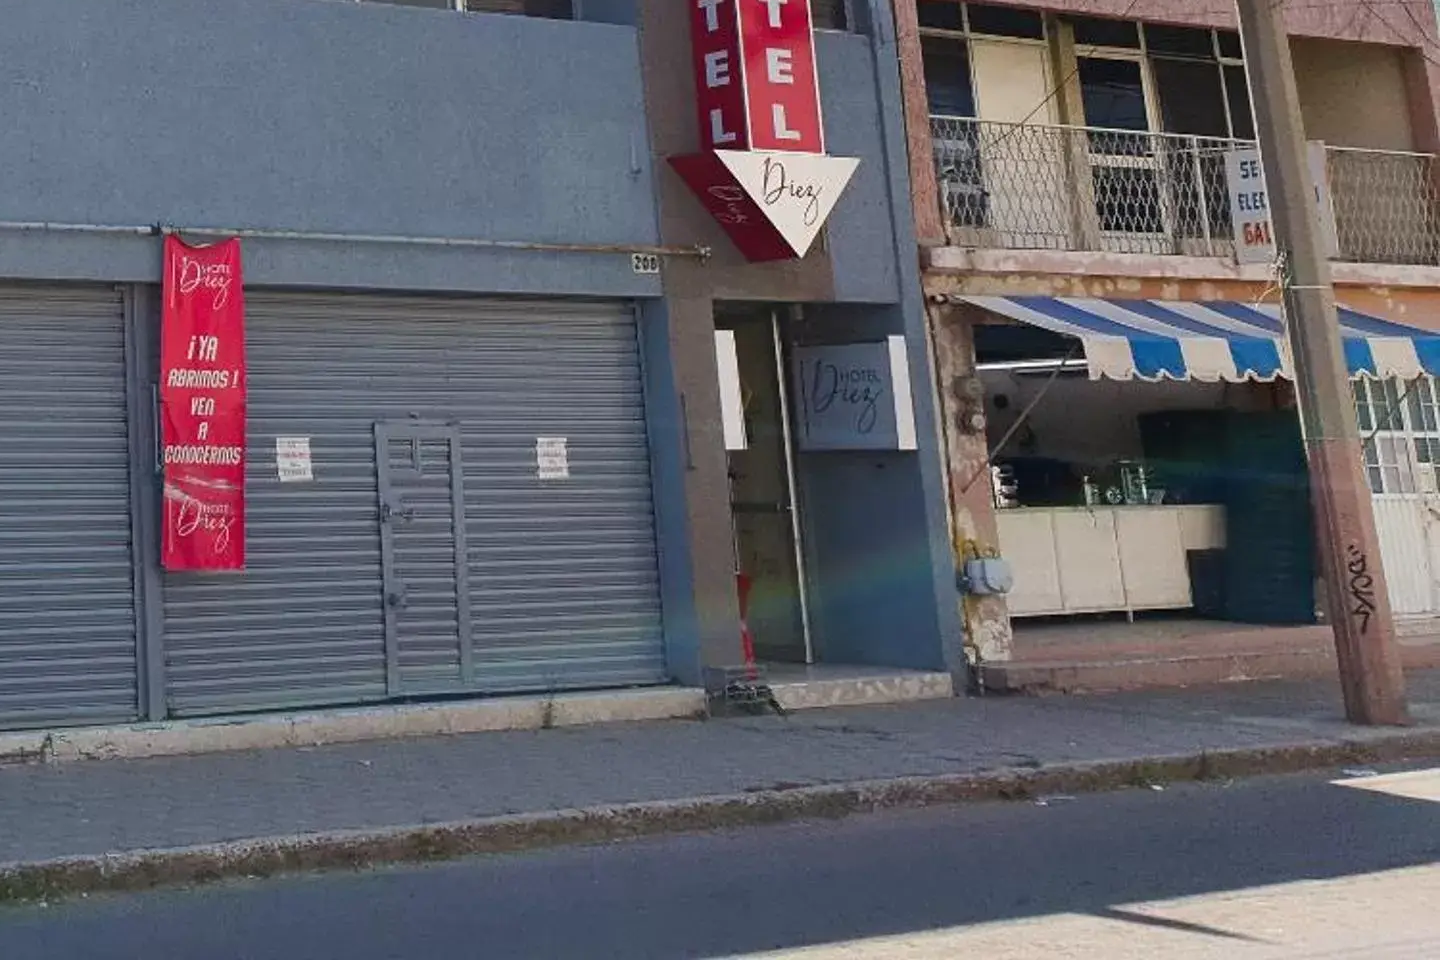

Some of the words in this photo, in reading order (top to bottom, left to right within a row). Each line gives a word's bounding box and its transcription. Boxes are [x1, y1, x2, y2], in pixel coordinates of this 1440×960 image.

[763, 156, 823, 227] Diez
[190, 396, 216, 416] VEN
[197, 421, 209, 440] A
